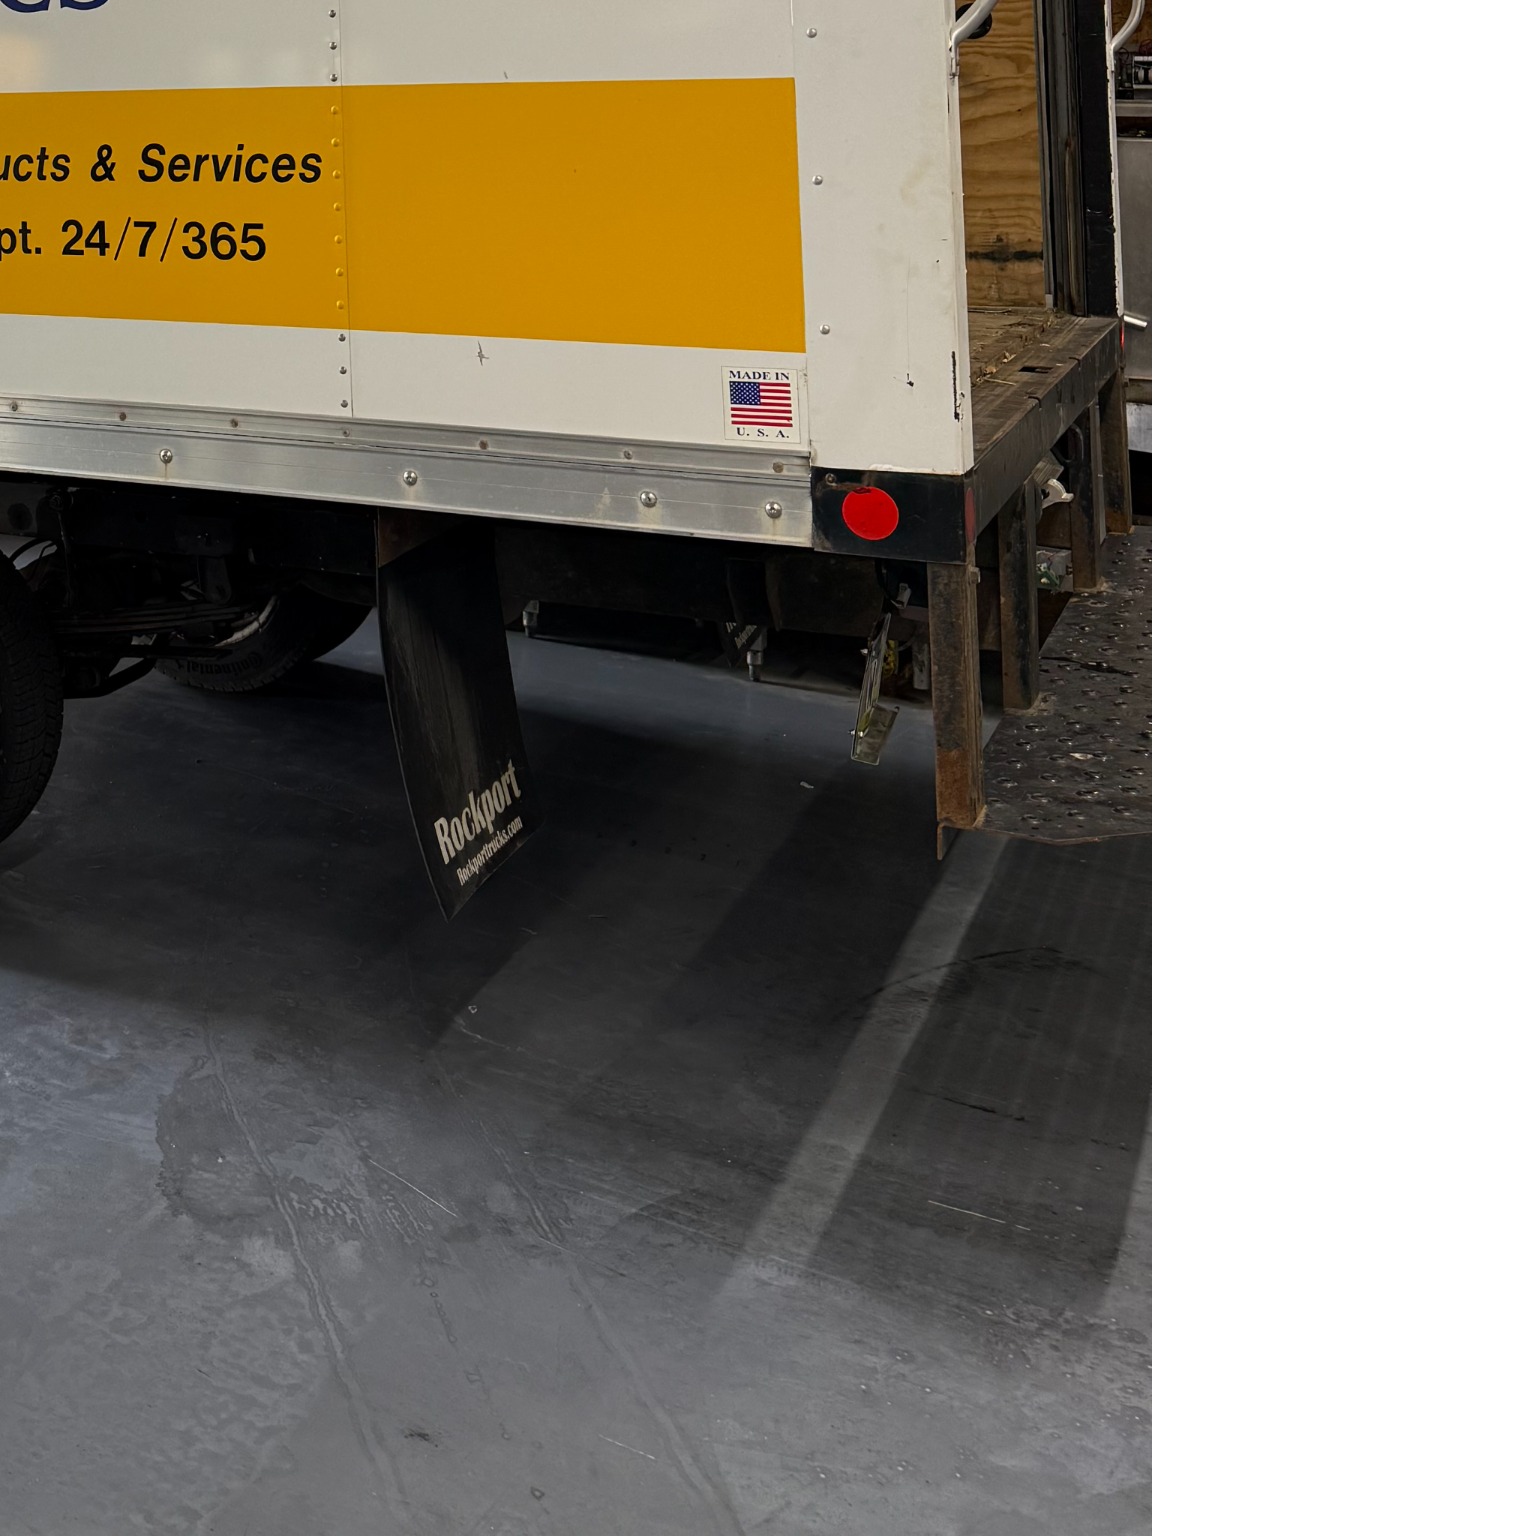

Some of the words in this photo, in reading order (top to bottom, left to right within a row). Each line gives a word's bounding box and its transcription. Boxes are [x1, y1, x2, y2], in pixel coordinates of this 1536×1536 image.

[91, 144, 116, 182] &
[138, 143, 322, 183] Services
[62, 217, 266, 262] 24/7/365
[729, 370, 772, 381] MADE
[774, 372, 791, 382] IN
[434, 758, 522, 865] Rockport
[456, 815, 524, 886] Rockporttrucks.com
